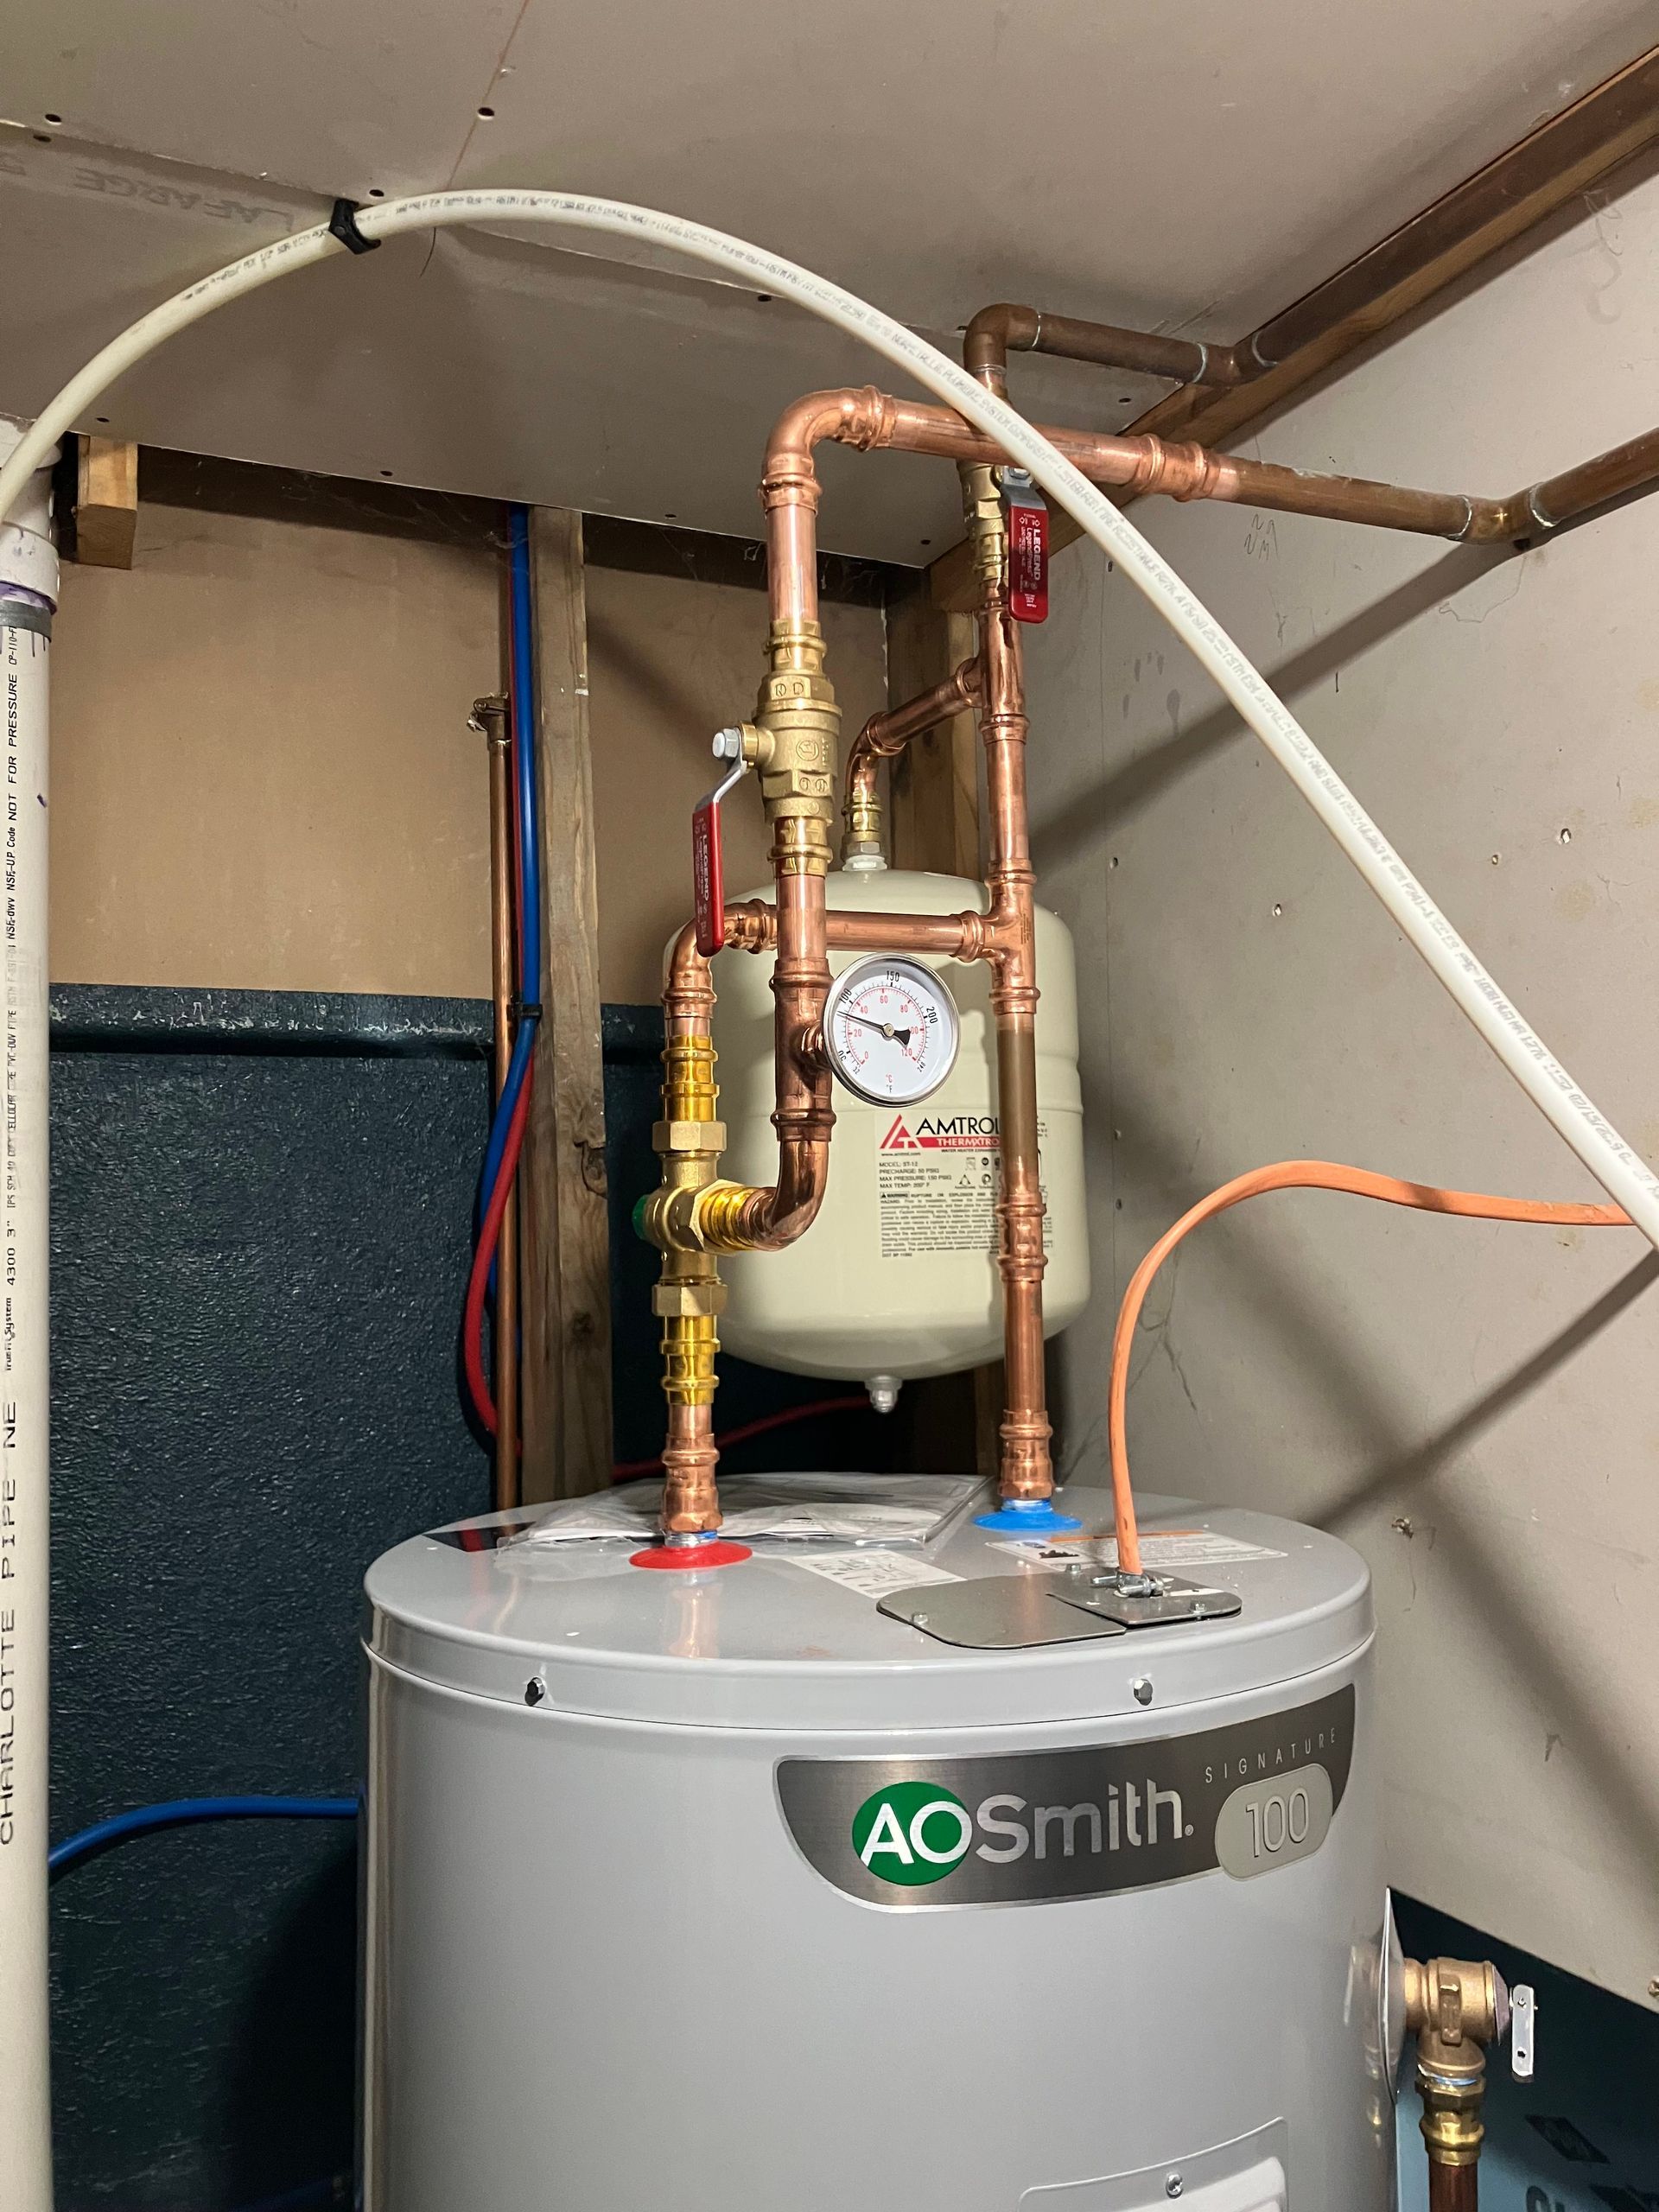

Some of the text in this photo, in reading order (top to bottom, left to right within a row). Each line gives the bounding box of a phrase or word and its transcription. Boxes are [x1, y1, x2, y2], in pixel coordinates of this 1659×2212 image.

[8, 673, 17, 747] PRESSURE
[8, 756, 16, 784] FOR
[8, 793, 16, 821] NOT
[7, 827, 16, 848] Code
[887, 970, 899, 982] 150
[838, 988, 852, 1003] 100
[926, 1007, 938, 1024] 200
[854, 1028, 862, 1037] 20
[916, 1117, 1000, 1135] AMTROL
[936, 1138, 1001, 1147] THERMXTRO
[6, 1248, 16, 1286] 4300
[3, 1402, 16, 1448] NE
[2, 1479, 15, 1579] PIPE
[0, 1610, 14, 1845] CHARLOTTE
[1205, 1729, 1337, 1784] SIGNATURE
[1245, 1786, 1310, 1859] 100
